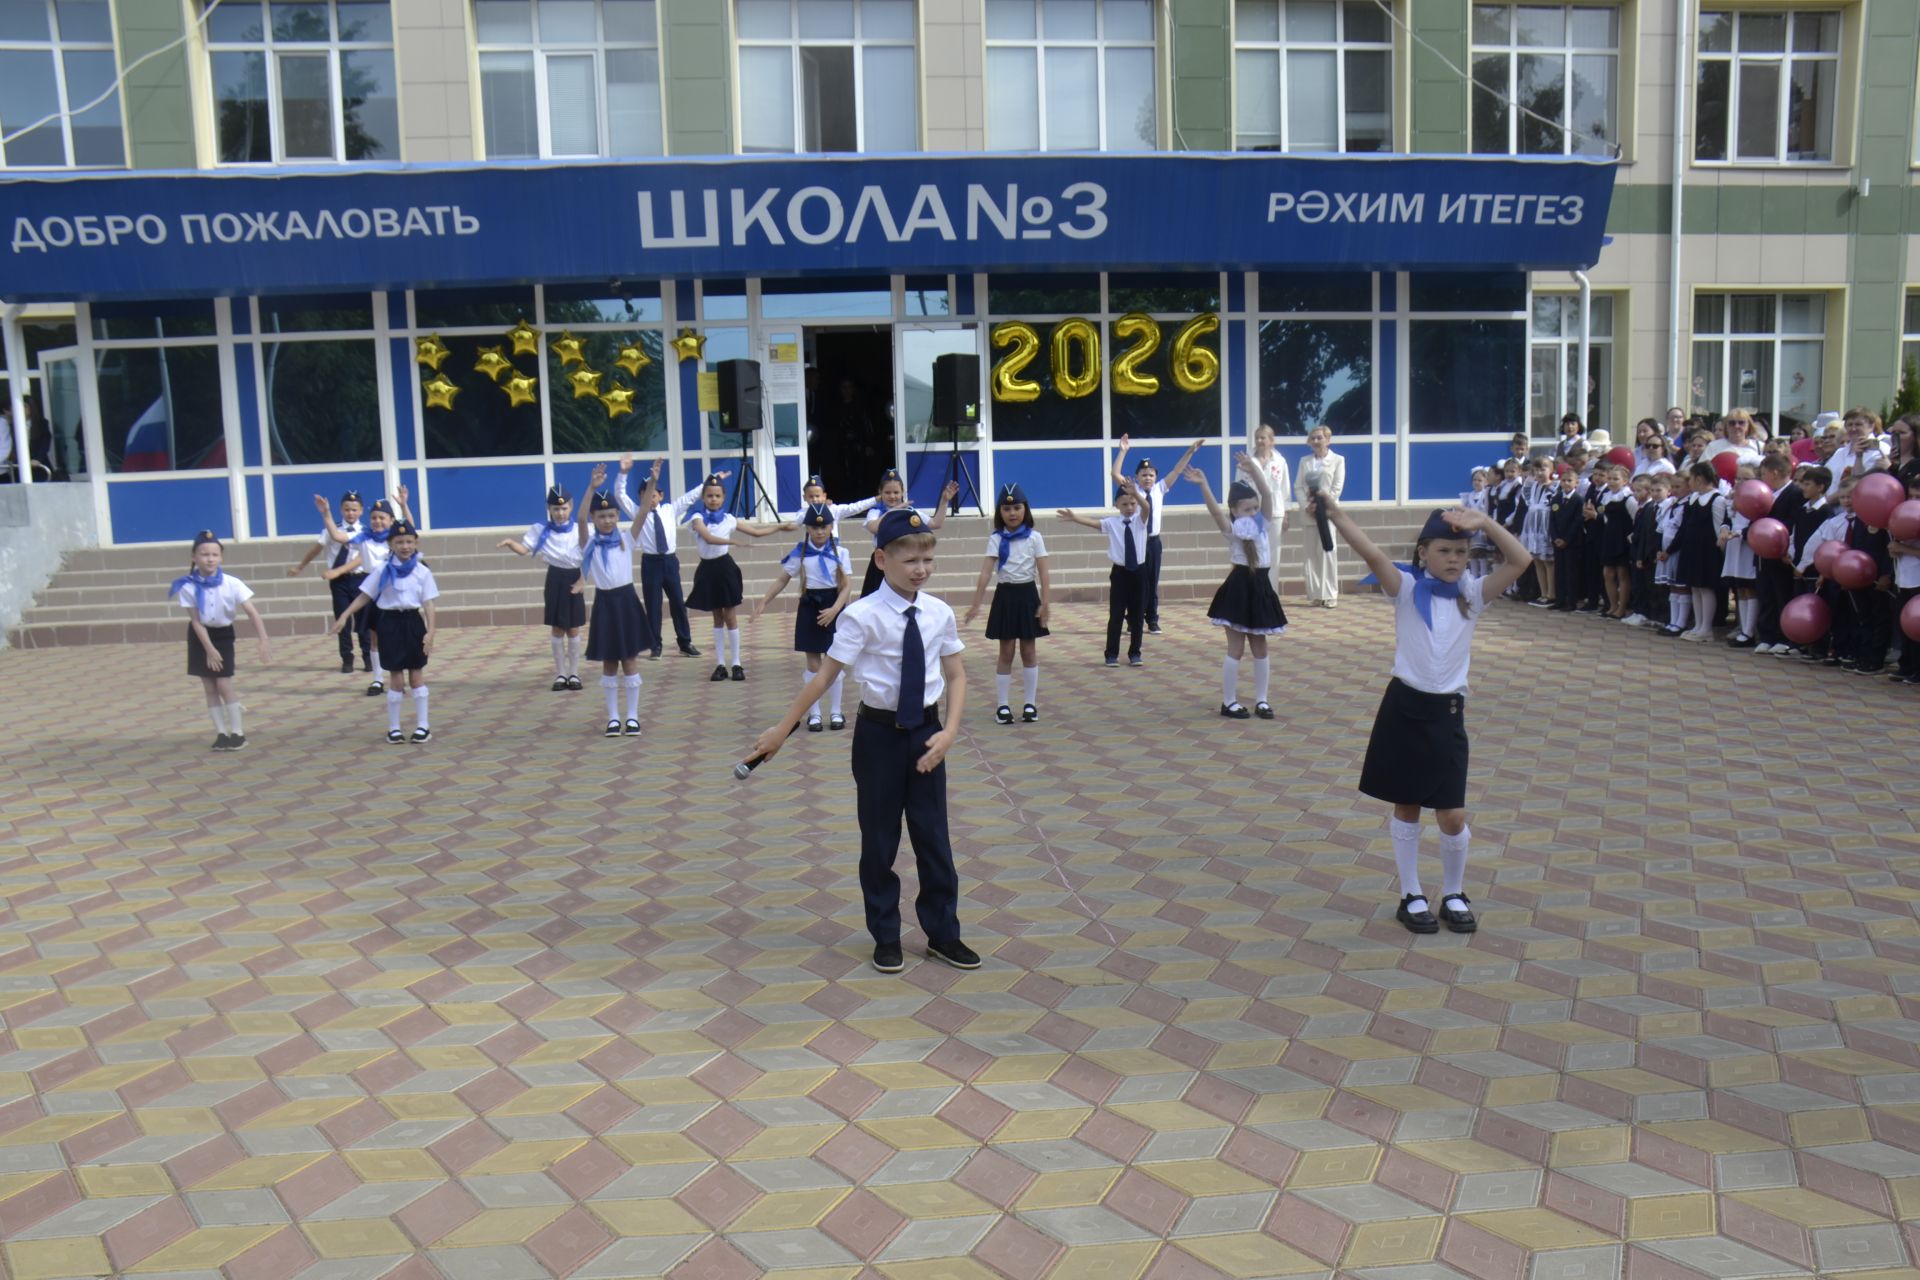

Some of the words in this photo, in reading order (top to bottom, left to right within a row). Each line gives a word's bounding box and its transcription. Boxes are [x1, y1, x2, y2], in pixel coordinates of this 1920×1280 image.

[11, 213, 168, 254] ДОБРО
[180, 205, 481, 245] ПОЖАЛОВАТЬ
[637, 184, 958, 249] ШКОЛА
[966, 181, 1109, 241] №3
[1267, 190, 1425, 224] РӘХИМ
[1438, 193, 1585, 226] ИТЕГЕЗ
[990, 312, 1220, 403] 2026
